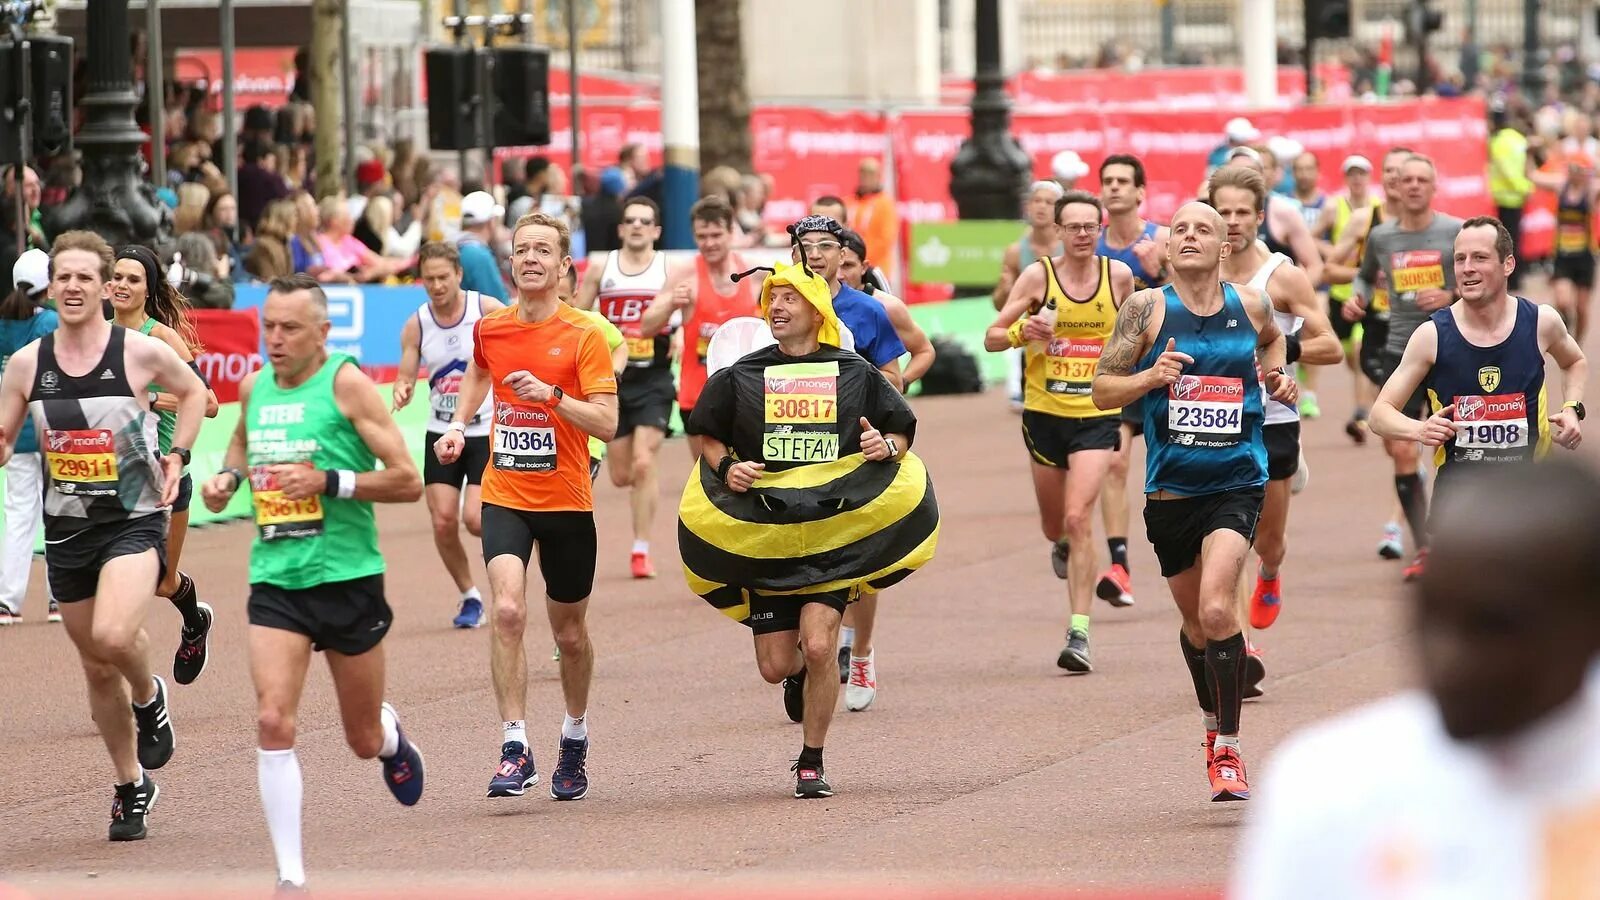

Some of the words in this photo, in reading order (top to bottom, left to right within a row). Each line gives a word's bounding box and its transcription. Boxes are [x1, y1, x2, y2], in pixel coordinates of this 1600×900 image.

[1072, 343, 1103, 353] money
[797, 380, 834, 390] money
[1173, 377, 1201, 398] Virgin
[1203, 384, 1241, 396] money
[440, 396, 457, 409] 28
[773, 399, 834, 418] 30817
[1459, 398, 1484, 419] Virgin
[1488, 401, 1524, 412] money
[516, 411, 549, 422] money
[1177, 407, 1239, 428] 23584
[73, 436, 111, 447] money
[500, 430, 554, 451] 70364
[1465, 424, 1520, 444] 1908
[766, 437, 838, 460] STEFAN
[55, 458, 112, 477] 29911
